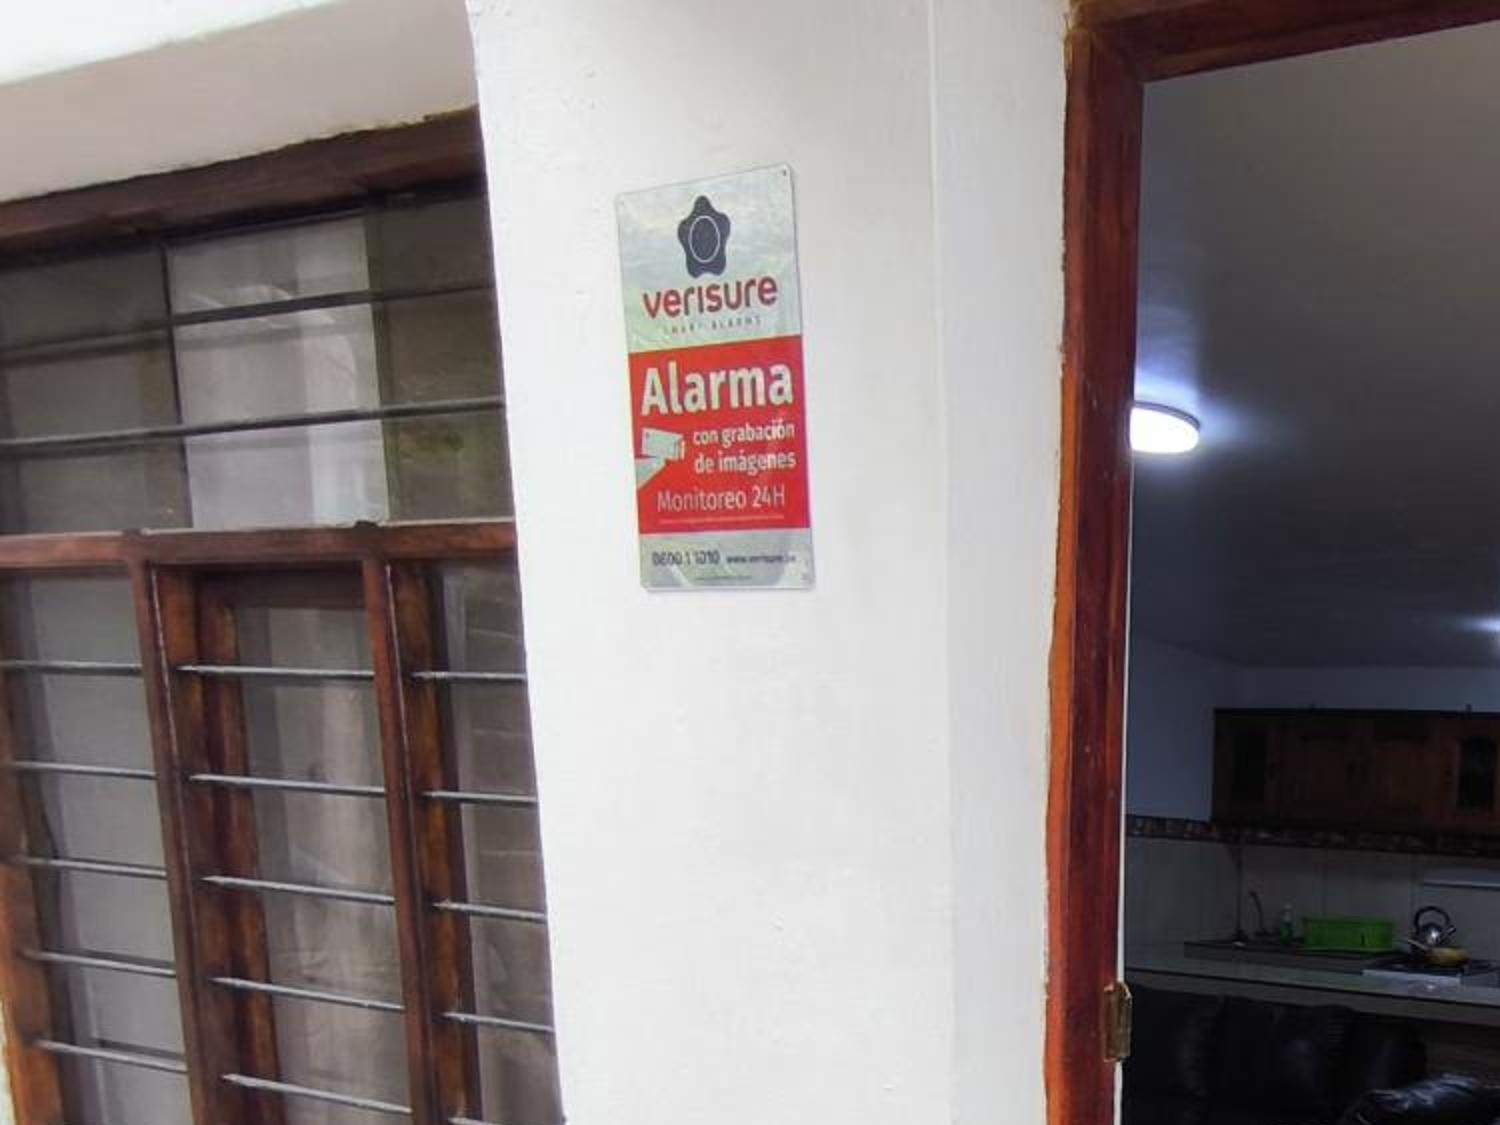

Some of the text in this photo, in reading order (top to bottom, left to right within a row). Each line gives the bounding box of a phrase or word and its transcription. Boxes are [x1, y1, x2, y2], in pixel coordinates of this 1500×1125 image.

[642, 276, 778, 319] verisure
[641, 361, 794, 416] Alarma
[693, 420, 795, 448] con grabación
[694, 450, 796, 475] de imágenes
[656, 484, 785, 512] Monitoreo 24H
